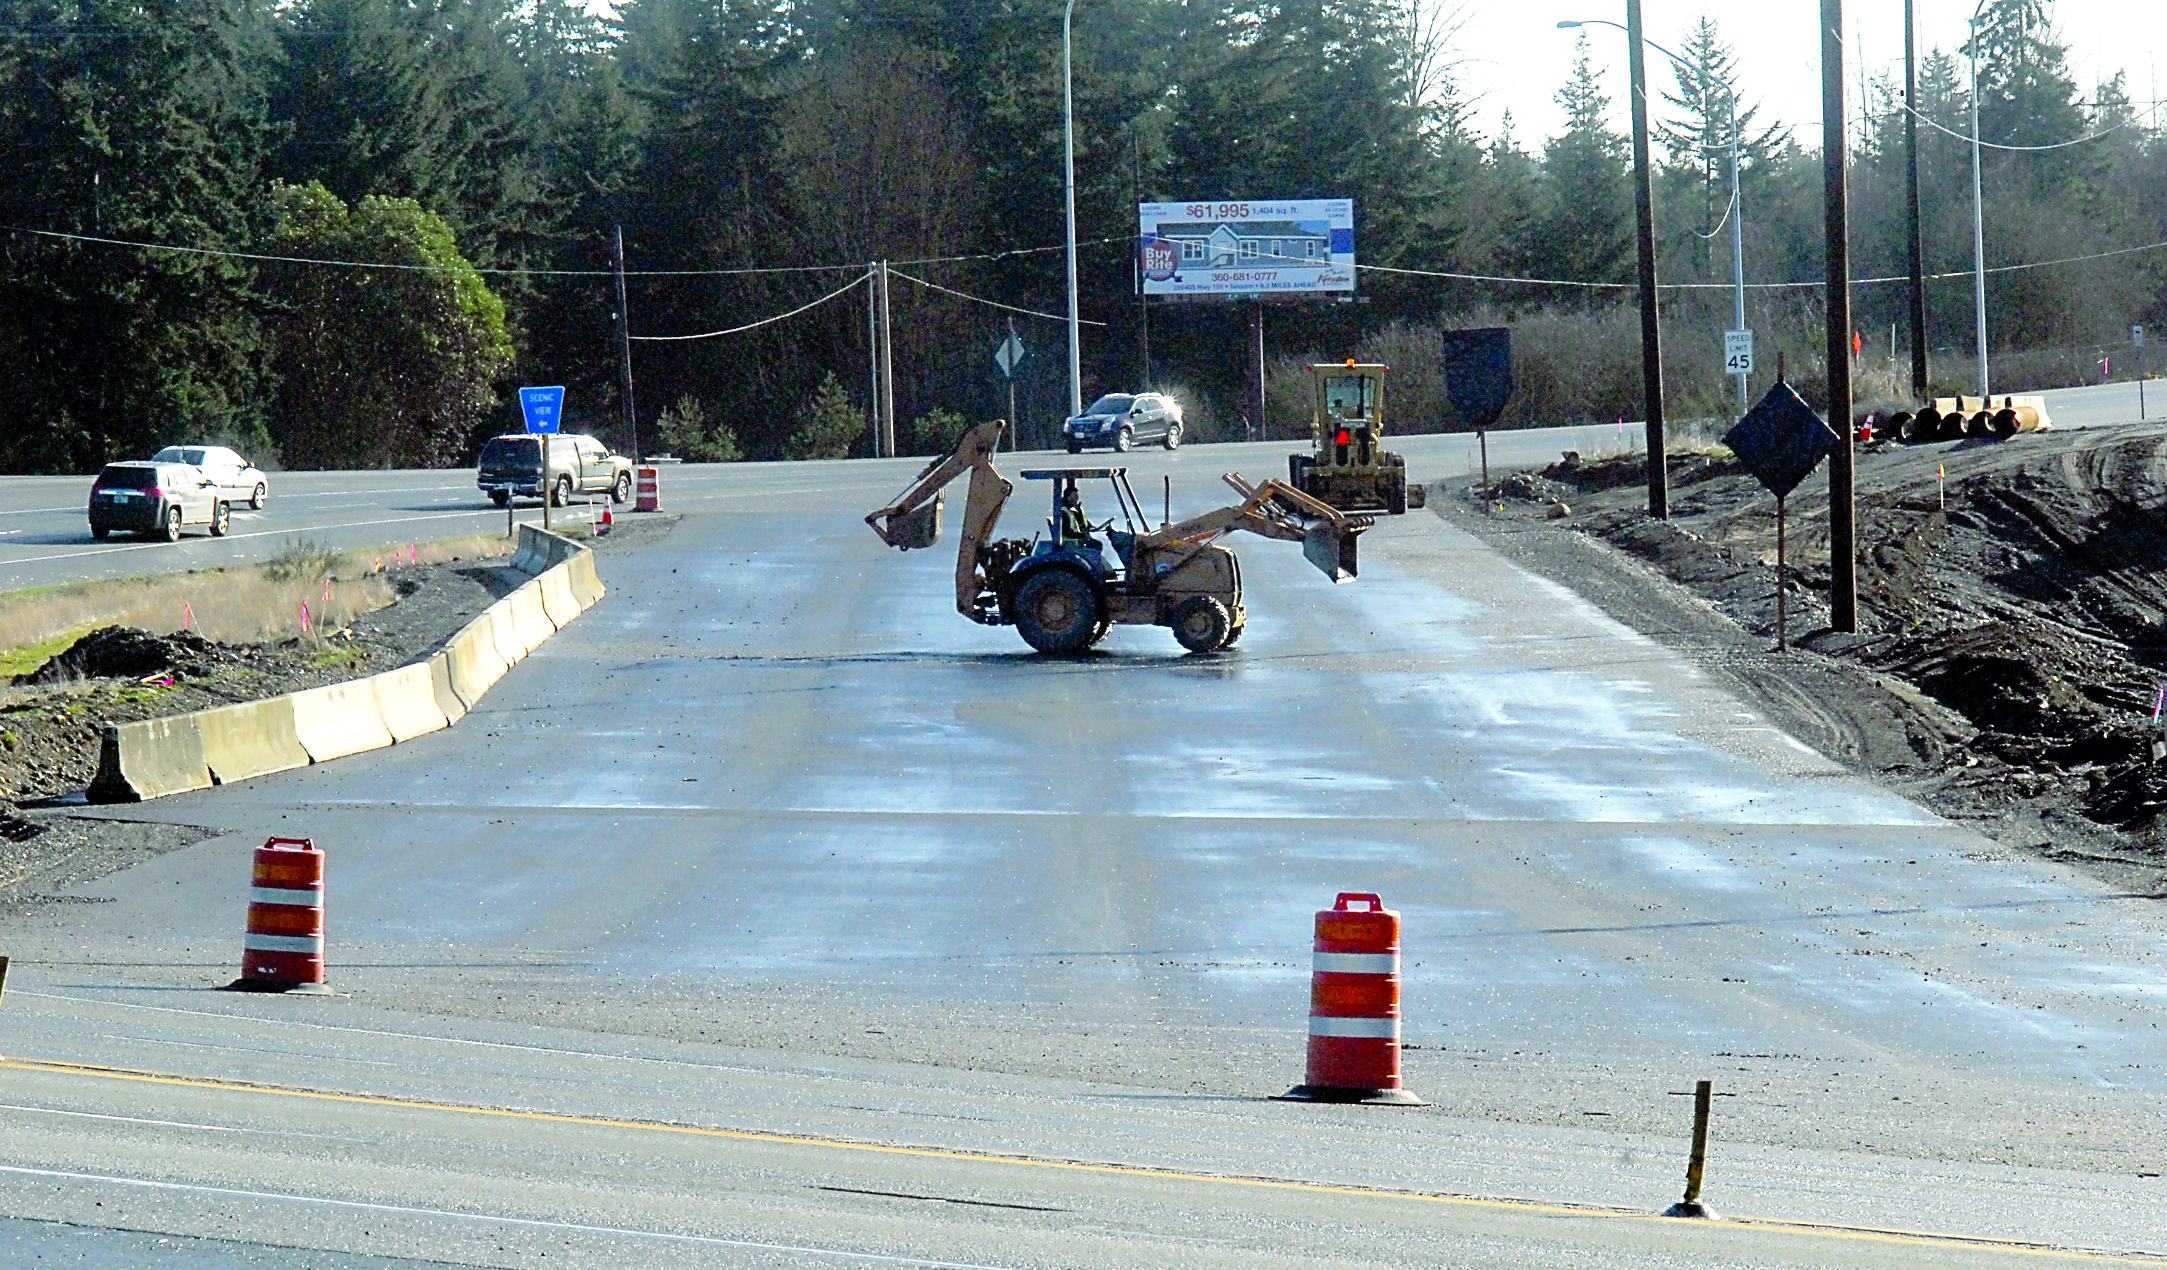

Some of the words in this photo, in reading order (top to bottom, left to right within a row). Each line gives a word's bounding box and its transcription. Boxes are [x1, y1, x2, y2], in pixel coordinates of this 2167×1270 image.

[1186, 203, 1249, 221] $61,995
[1252, 206, 1274, 215] 1,404
[1290, 206, 1299, 214] ft.
[1145, 247, 1172, 262] Buy
[1146, 259, 1173, 270] Rite
[1211, 272, 1278, 282] 360-681-0777
[1728, 355, 1749, 368] 45
[530, 393, 554, 402] SCENIC
